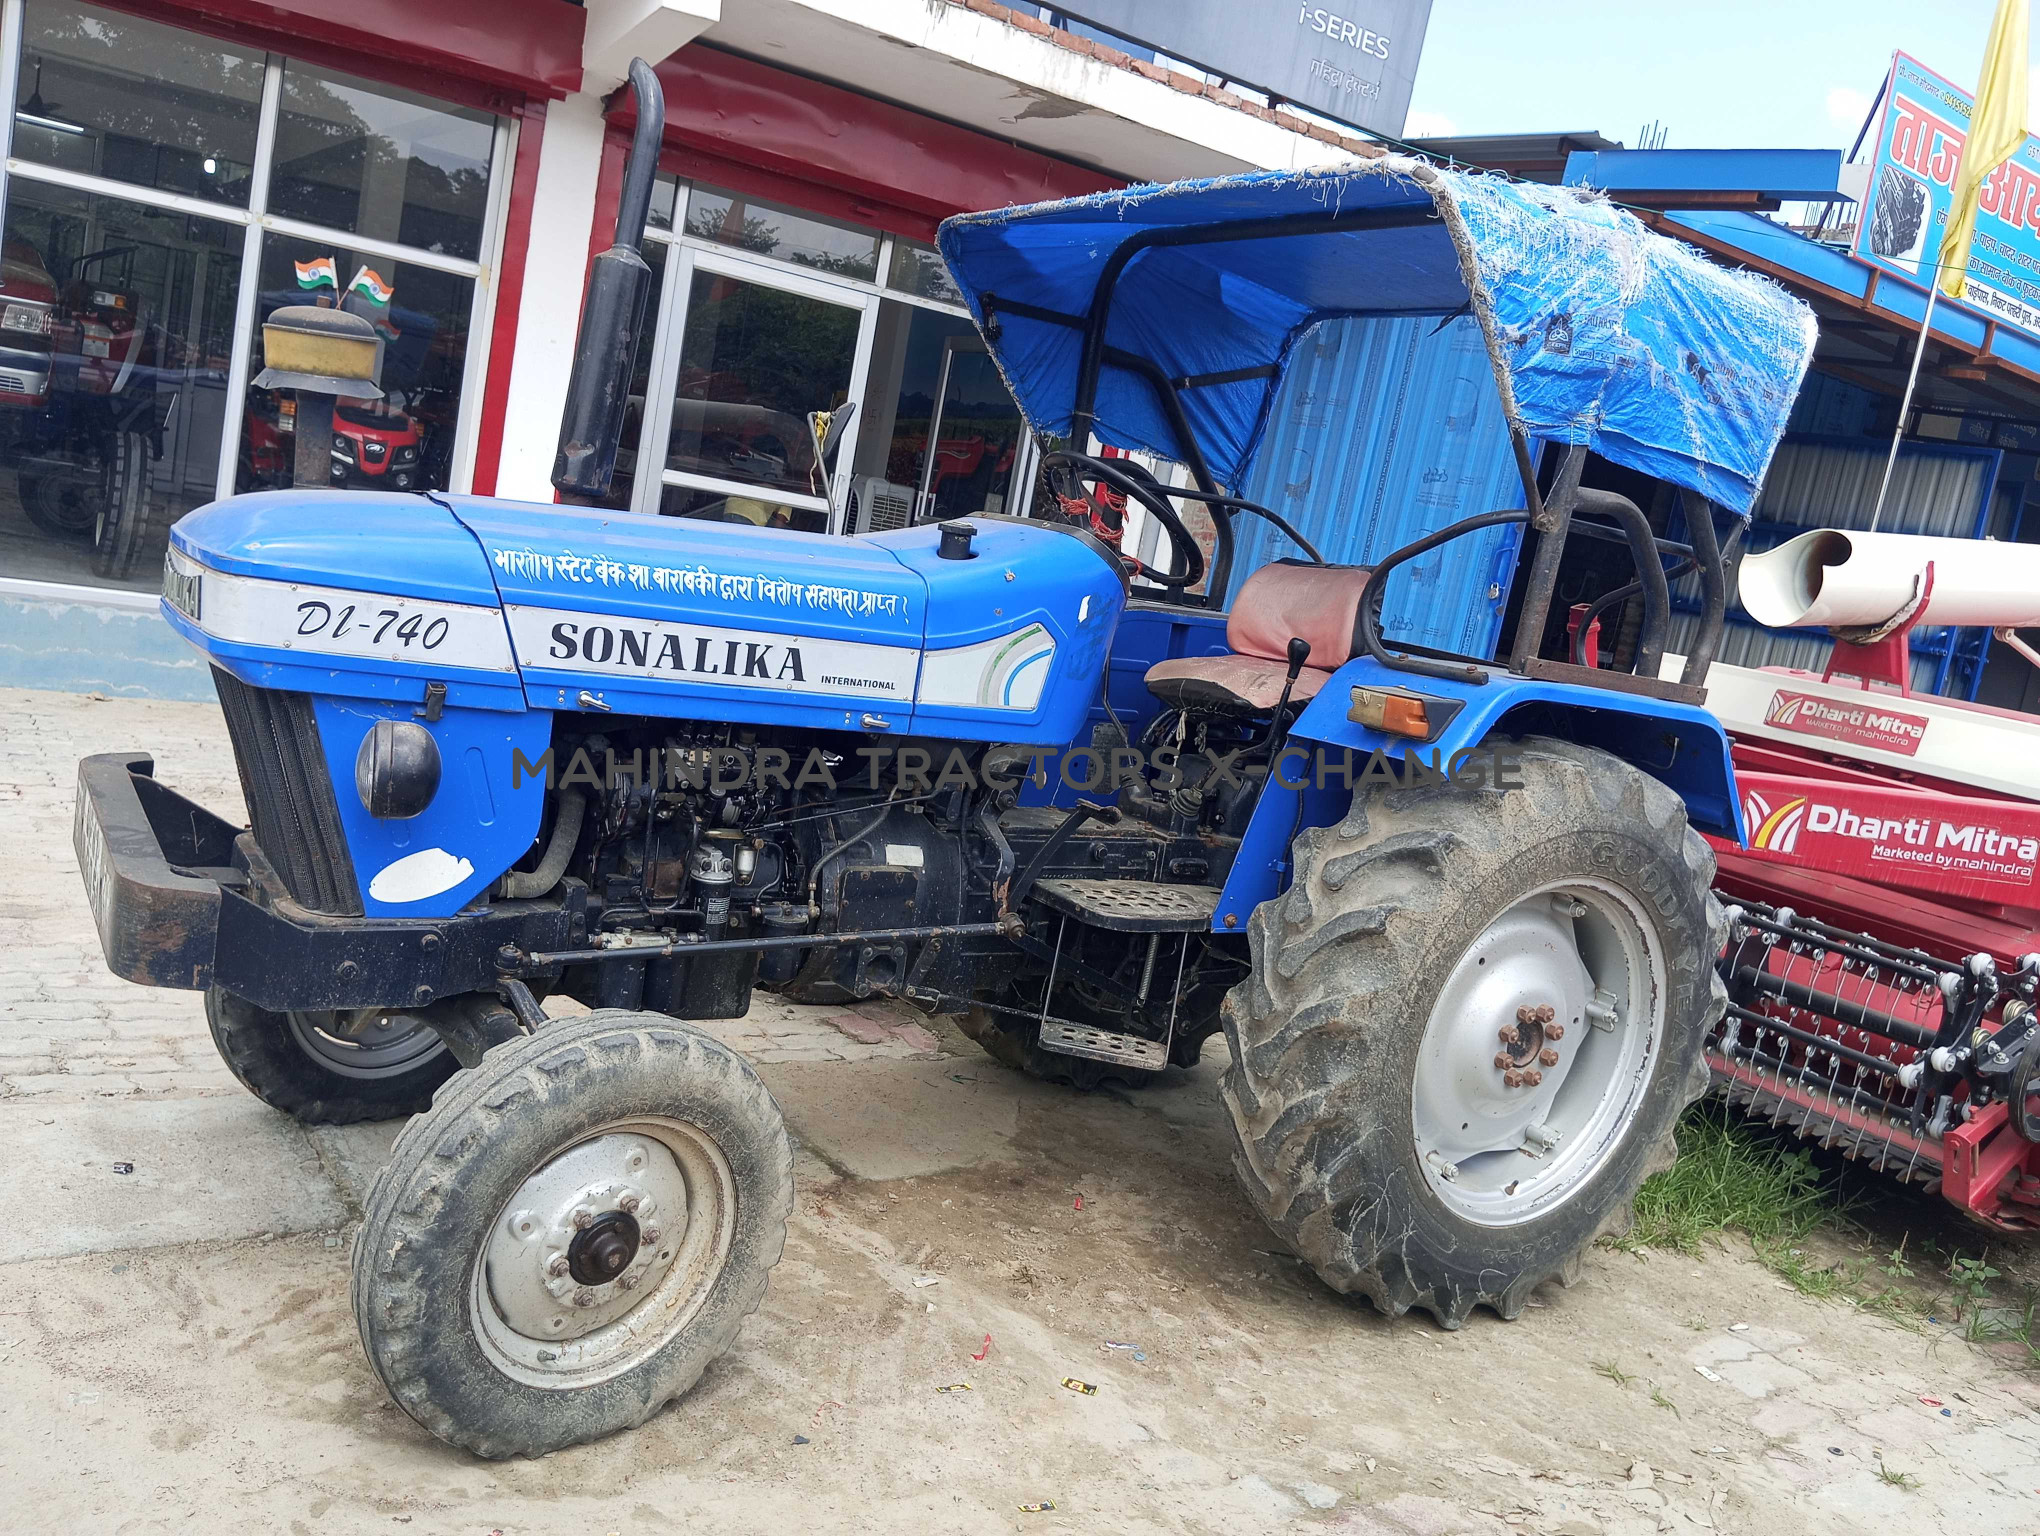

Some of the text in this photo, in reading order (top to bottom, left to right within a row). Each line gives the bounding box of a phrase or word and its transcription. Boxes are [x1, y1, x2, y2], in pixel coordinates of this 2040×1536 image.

[1299, 0, 1391, 60] i-SERIES
[493, 547, 555, 583] भारतीय
[555, 549, 595, 583] स्टेट
[592, 553, 627, 588] बैंक
[719, 574, 754, 601] द्वारा
[805, 584, 858, 618] सहायता
[549, 622, 807, 683] SONALIKA
[820, 675, 897, 691] INTERNATIONAL
[1801, 700, 1924, 739] Dharti Mitra
[1805, 718, 1842, 733] MARKETED
[1855, 728, 1908, 746] mahindra
[1806, 804, 2040, 861] Dharti Mitra
[1873, 844, 2032, 877] Marketed by mahindra
[1589, 840, 1695, 1097] GOODYEAR
